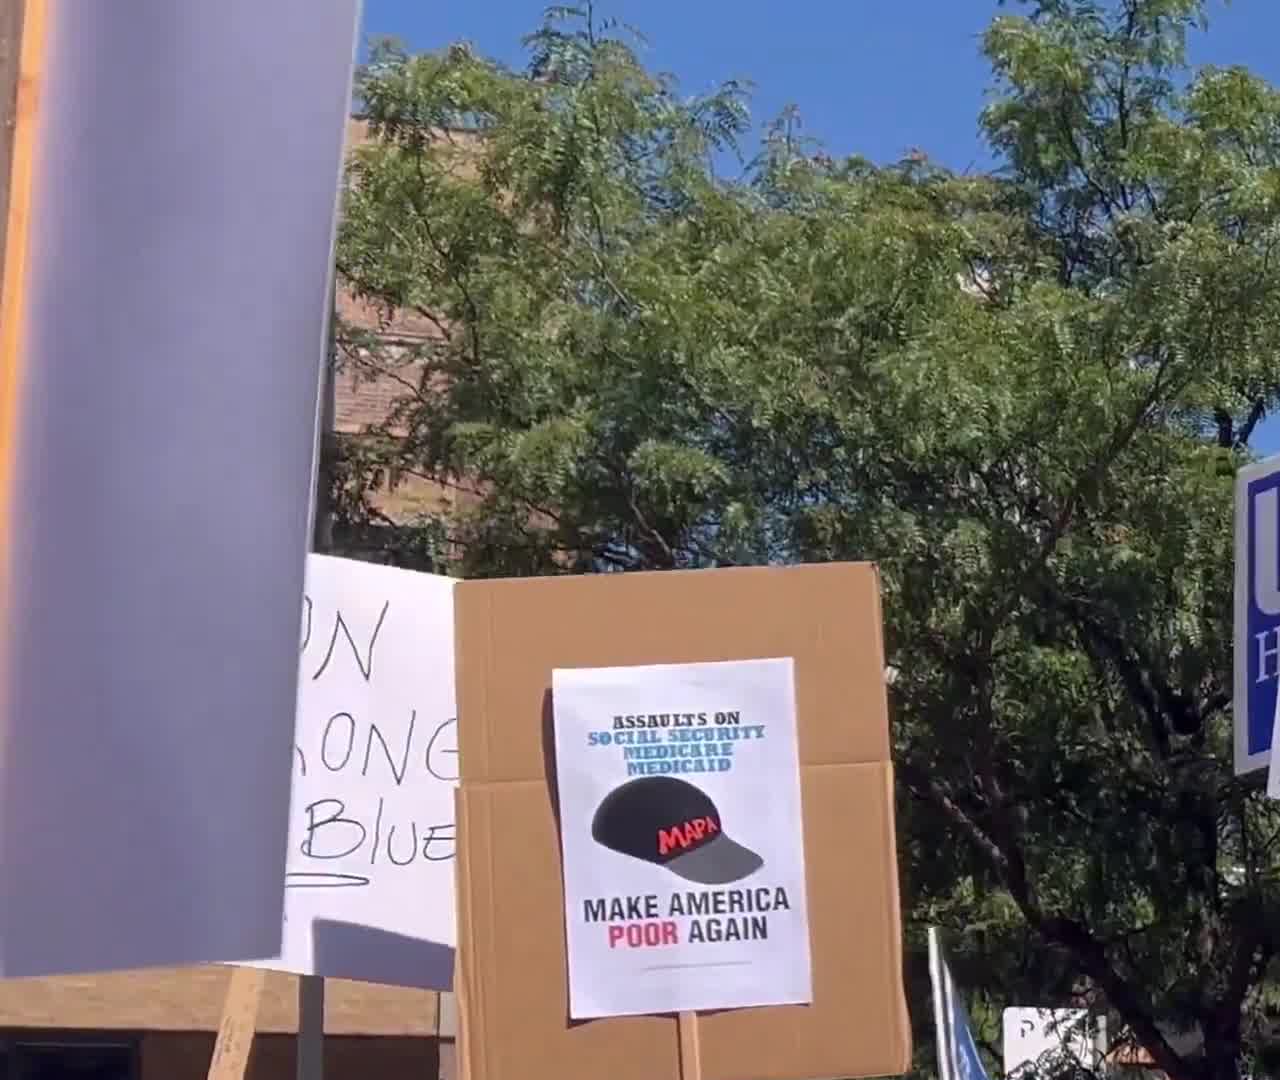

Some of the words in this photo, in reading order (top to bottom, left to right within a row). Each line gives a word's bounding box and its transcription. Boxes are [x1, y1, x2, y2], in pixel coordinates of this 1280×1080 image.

[613, 713, 708, 730] ASSAULTS
[714, 711, 741, 726] ON
[587, 729, 662, 747] SOCIAL
[668, 724, 766, 743] SECURITY
[624, 742, 734, 760] MEDICARE
[627, 758, 731, 776] MEDICAID
[657, 816, 718, 856] MAPA
[583, 895, 659, 923] MAKE
[668, 886, 791, 918] AMERICA
[608, 920, 679, 949] POOR
[688, 916, 769, 944] AGAIN
